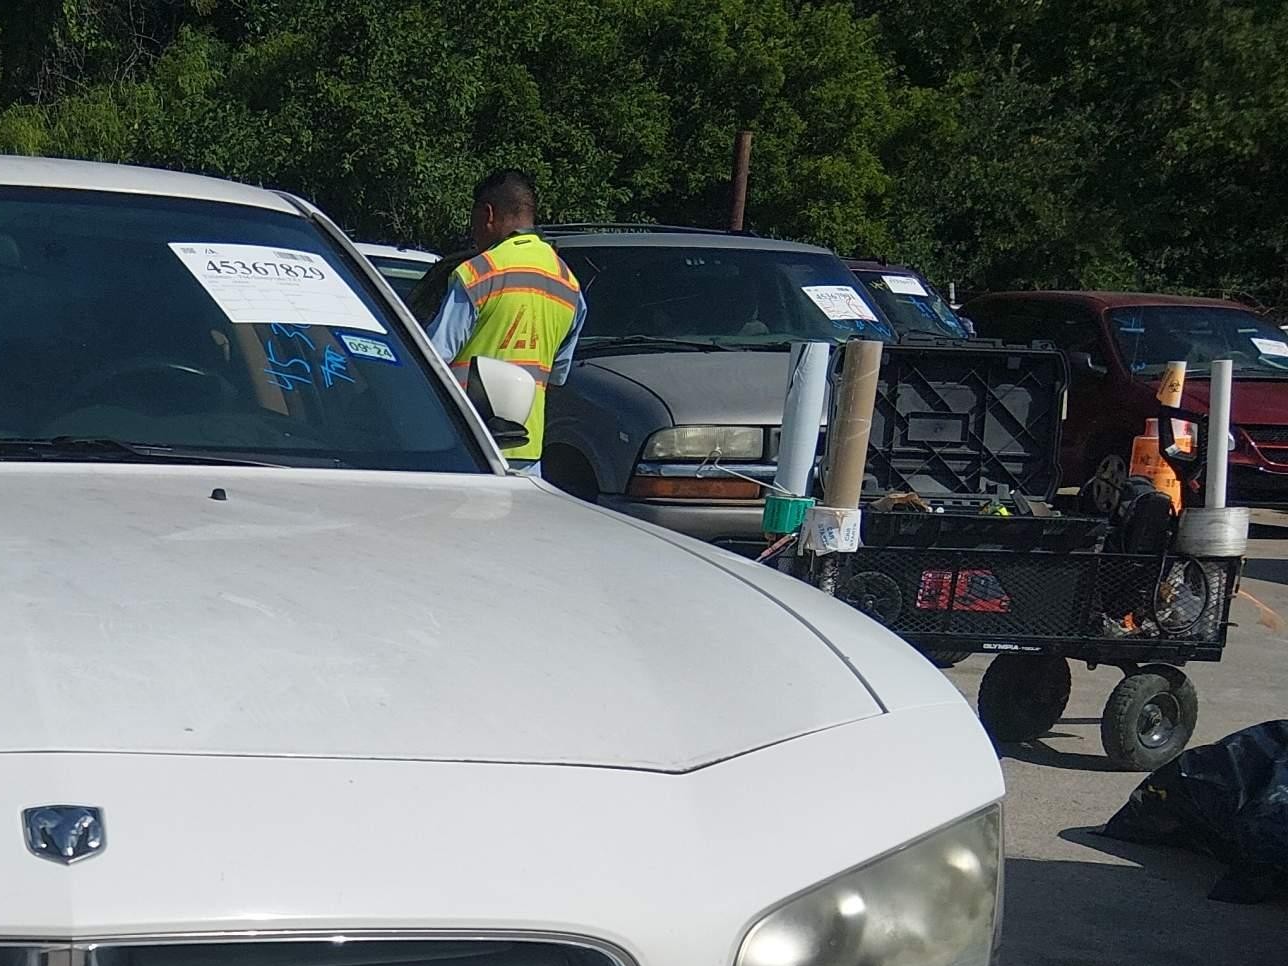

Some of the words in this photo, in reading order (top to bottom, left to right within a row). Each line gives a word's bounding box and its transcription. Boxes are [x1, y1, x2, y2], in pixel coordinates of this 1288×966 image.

[206, 260, 325, 280] 45367829
[349, 341, 369, 353] 09
[373, 345, 393, 359] 24
